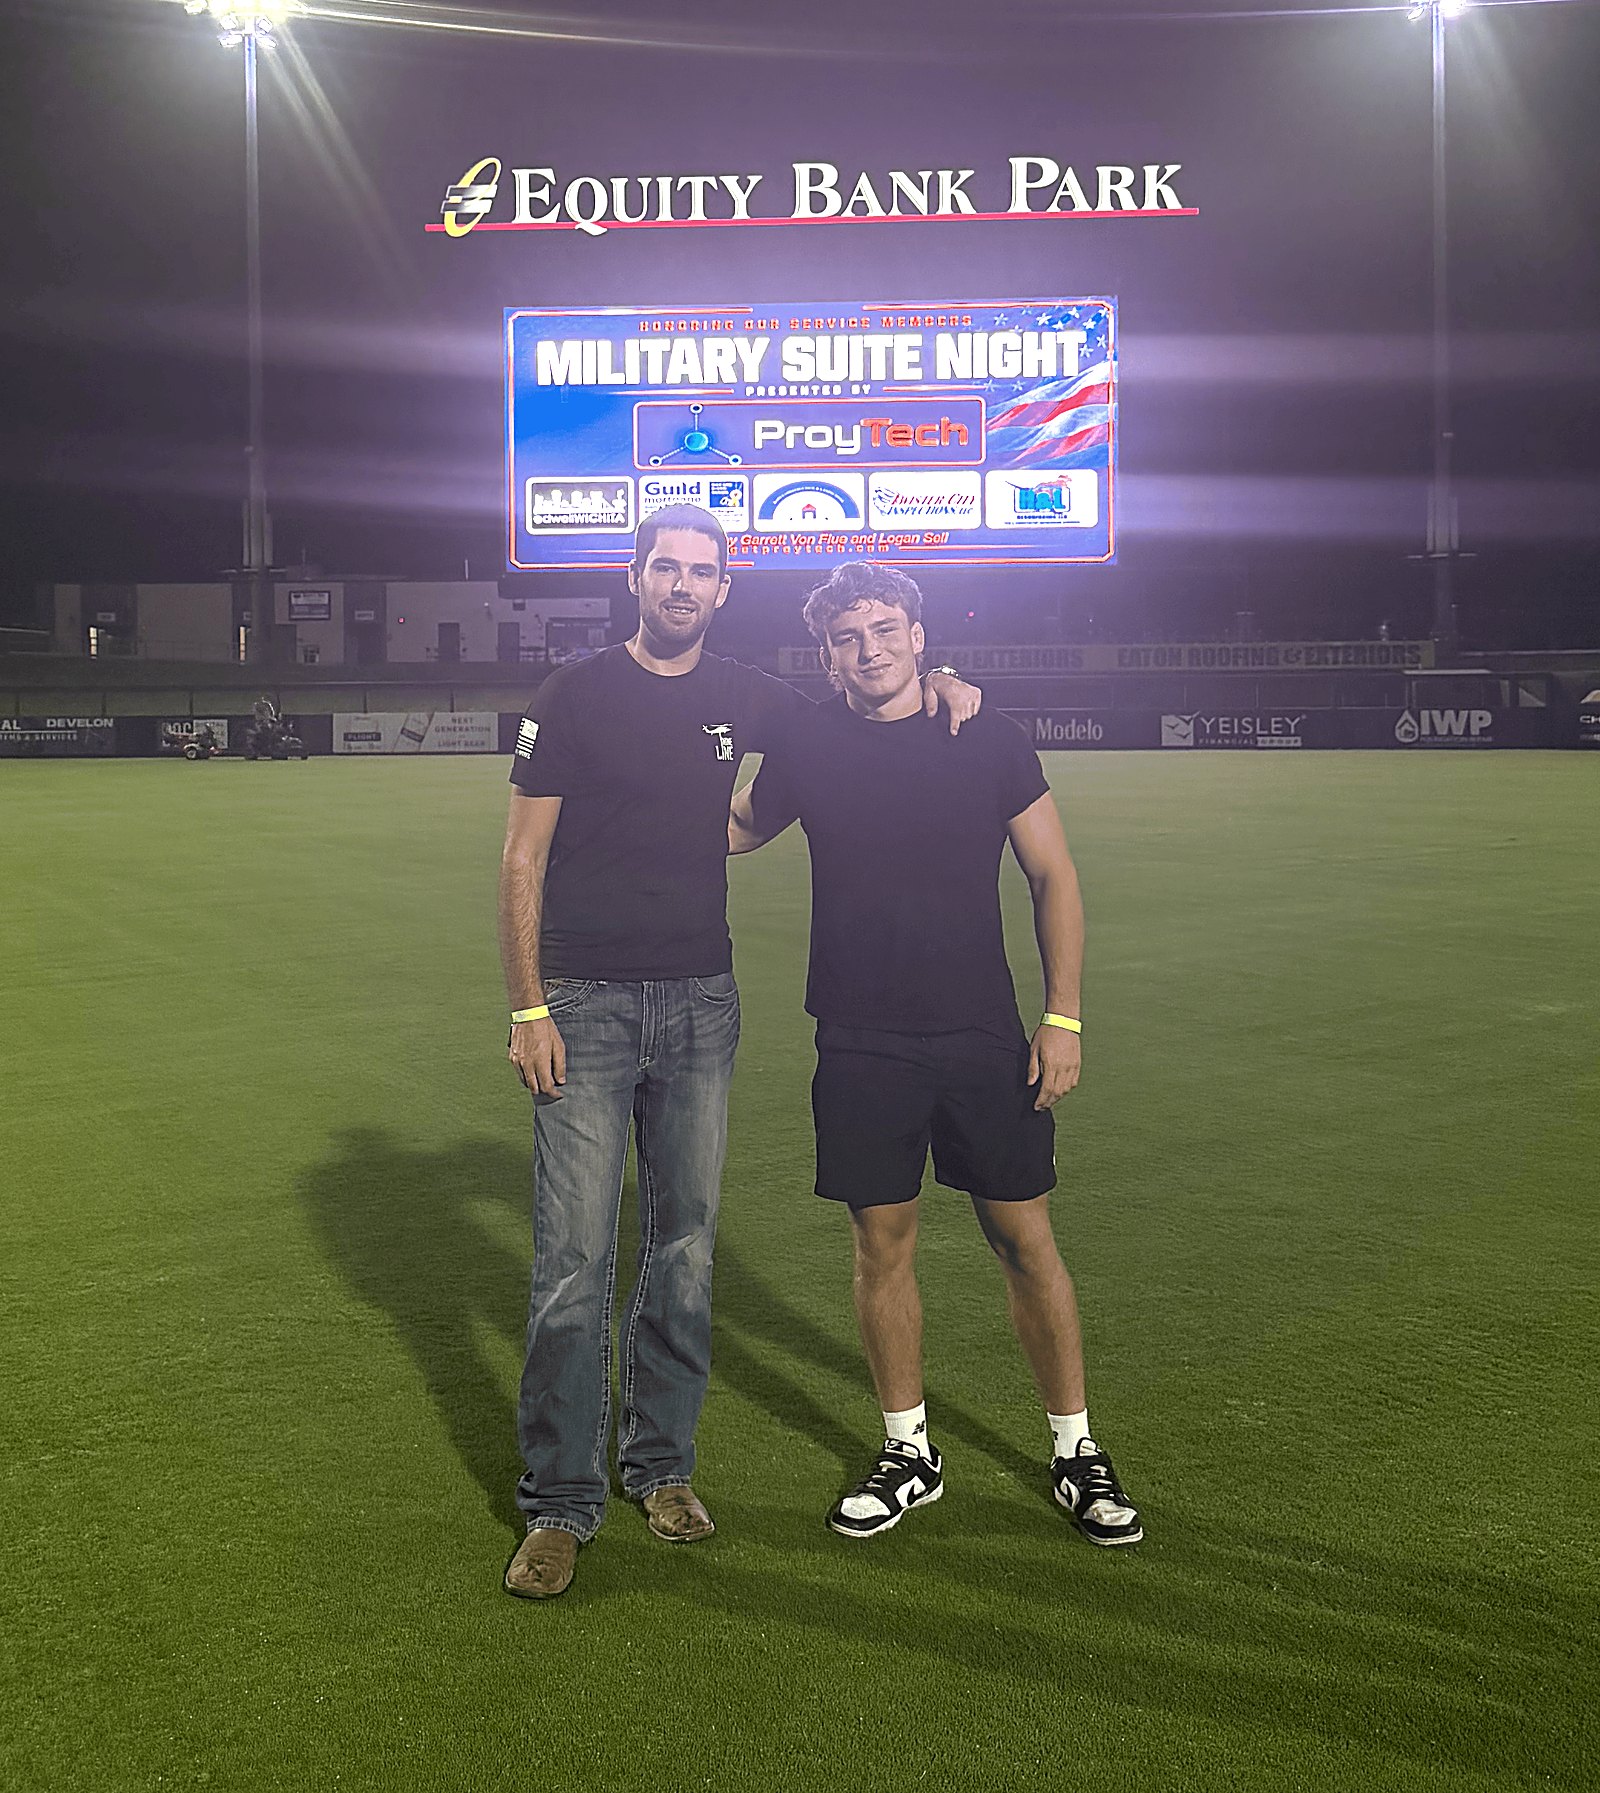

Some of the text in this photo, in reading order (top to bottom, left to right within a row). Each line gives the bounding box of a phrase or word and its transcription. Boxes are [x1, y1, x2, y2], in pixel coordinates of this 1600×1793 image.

[511, 156, 1182, 236] EQUITY BANK PARK
[639, 315, 972, 332] HONORING OUR SERVICE MEMBERS
[536, 330, 1087, 386] MILITARY SUITE NIGHT
[745, 384, 871, 397] PRESENTED BY
[754, 416, 969, 455] ProyTech
[644, 481, 701, 496] Guild
[740, 534, 787, 546] Garrett
[790, 533, 816, 545] Von
[850, 532, 878, 545] and
[878, 531, 921, 549] Logan
[1118, 646, 1181, 667] EATON
[1188, 645, 1279, 667] ROOFING
[1304, 643, 1420, 666] EXTERIORS
[47, 718, 113, 728] DEVELON
[1036, 717, 1103, 741] Modelo
[1201, 717, 1301, 735] YEISLEY
[1420, 710, 1492, 736] IWP
